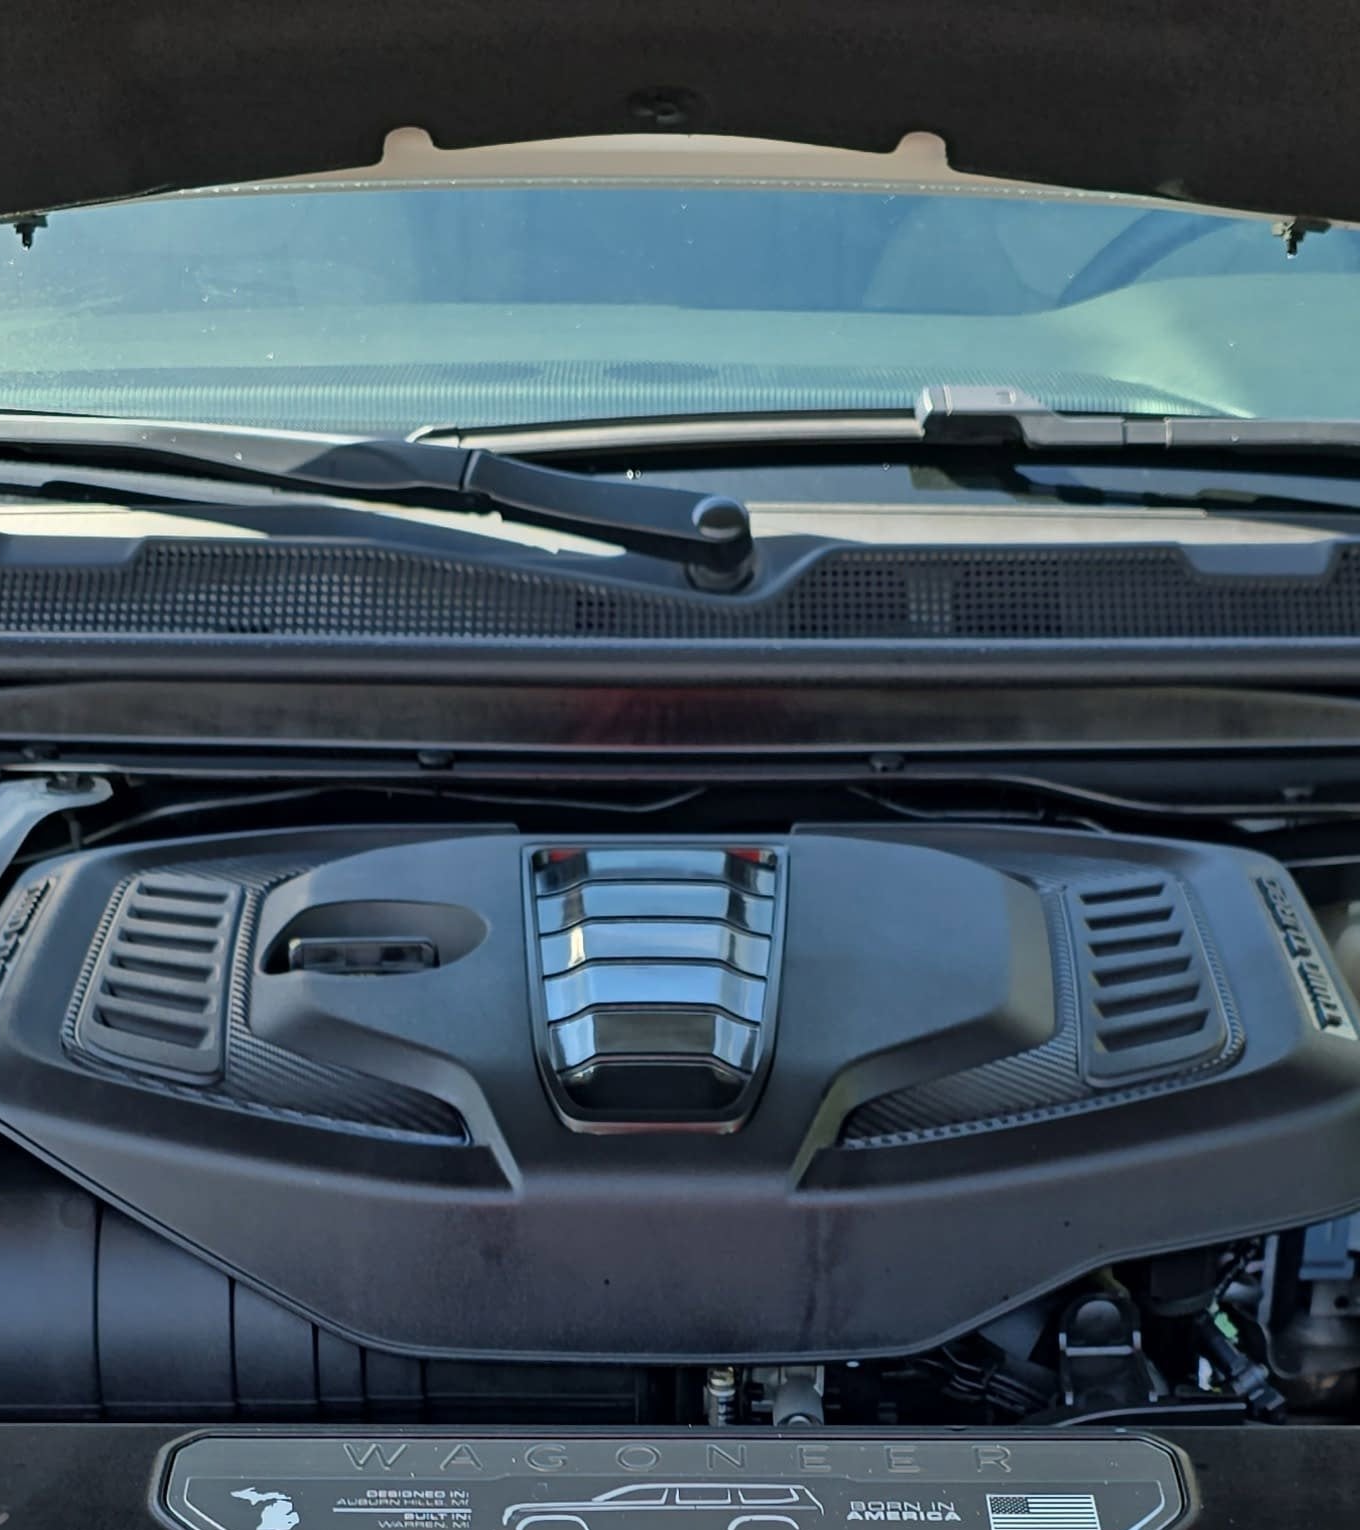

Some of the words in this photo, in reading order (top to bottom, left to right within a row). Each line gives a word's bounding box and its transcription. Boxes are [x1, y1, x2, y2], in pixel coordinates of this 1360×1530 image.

[343, 1444, 1012, 1473] WAGONEER
[366, 1489, 446, 1499] DESIGNED
[336, 1498, 400, 1506] AUBURN
[451, 1498, 469, 1506] MI
[850, 1501, 921, 1511] BORN
[932, 1501, 955, 1512] IN
[404, 1512, 447, 1521] BUILT
[846, 1511, 962, 1521] AMERICA
[452, 1520, 470, 1529] MI
